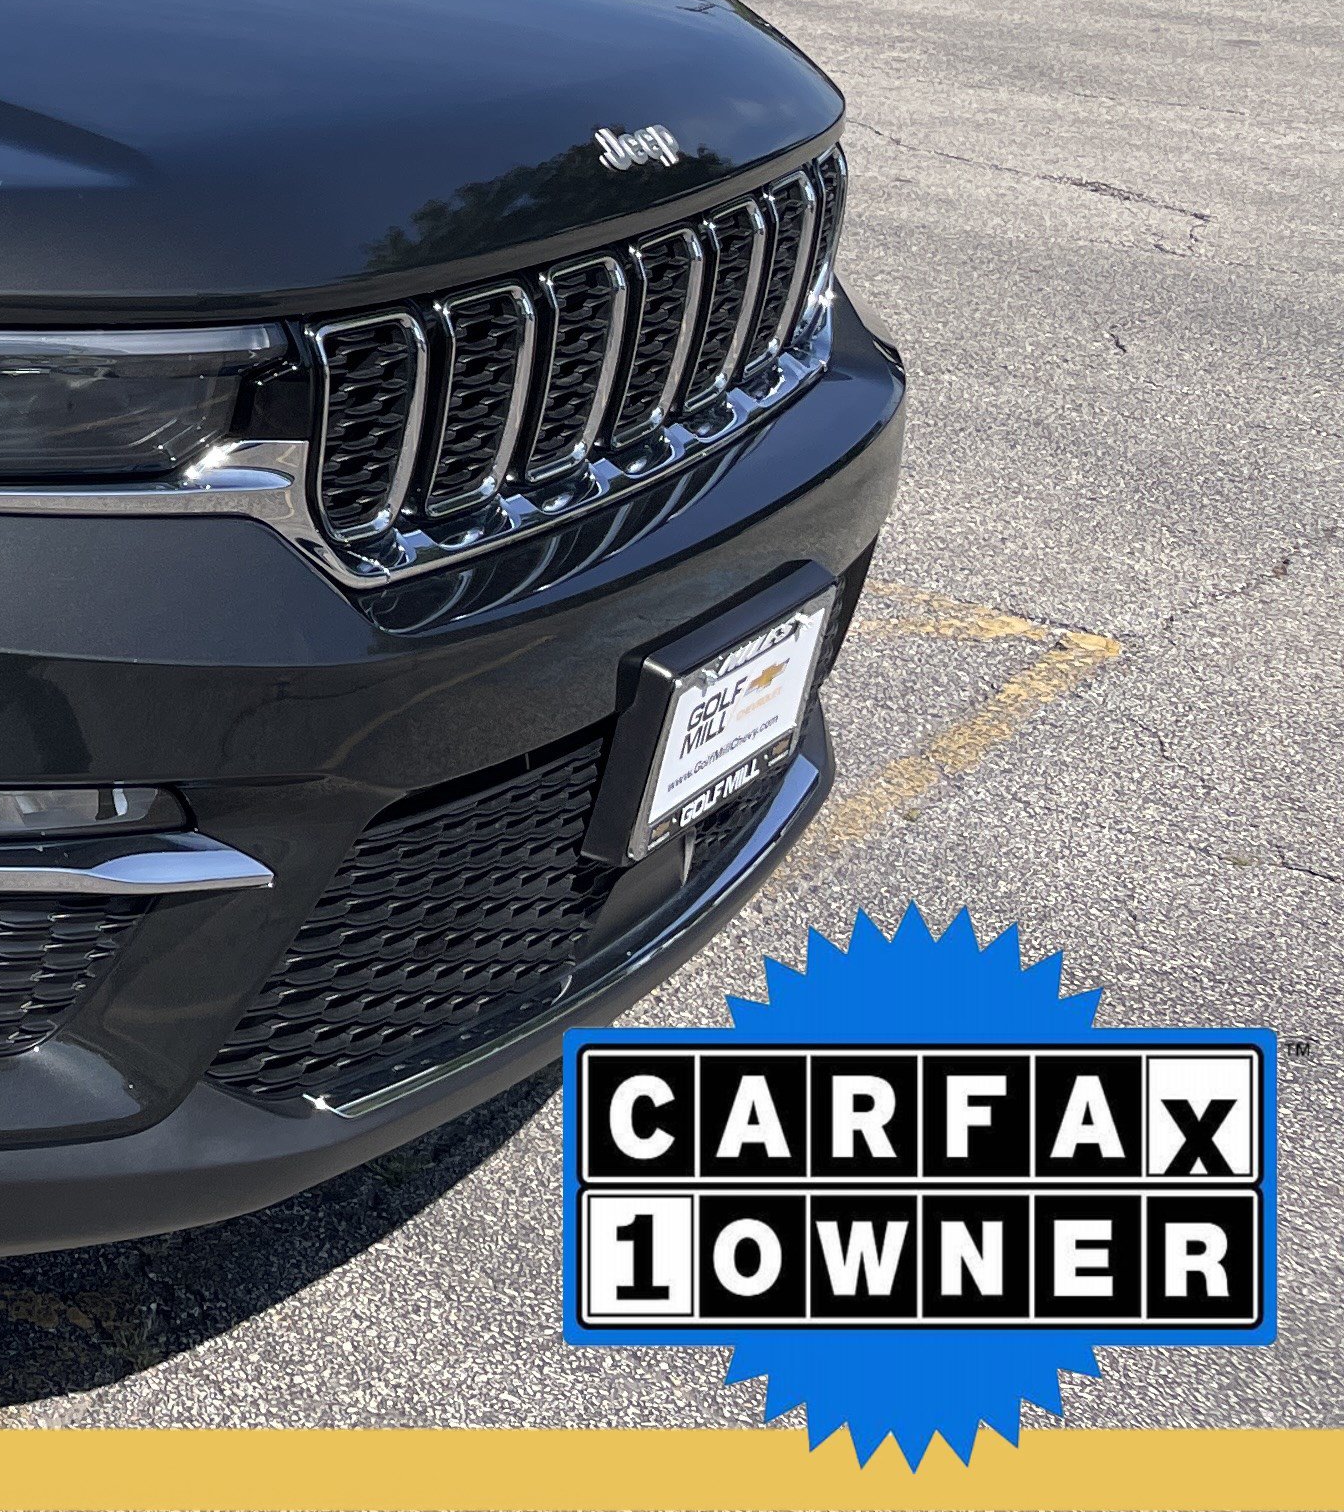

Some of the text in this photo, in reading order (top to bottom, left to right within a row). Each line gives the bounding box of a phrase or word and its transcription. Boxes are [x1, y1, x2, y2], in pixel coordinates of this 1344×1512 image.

[594, 124, 680, 172] Jeep
[687, 676, 748, 732] GOLF
[679, 710, 727, 760] MILL
